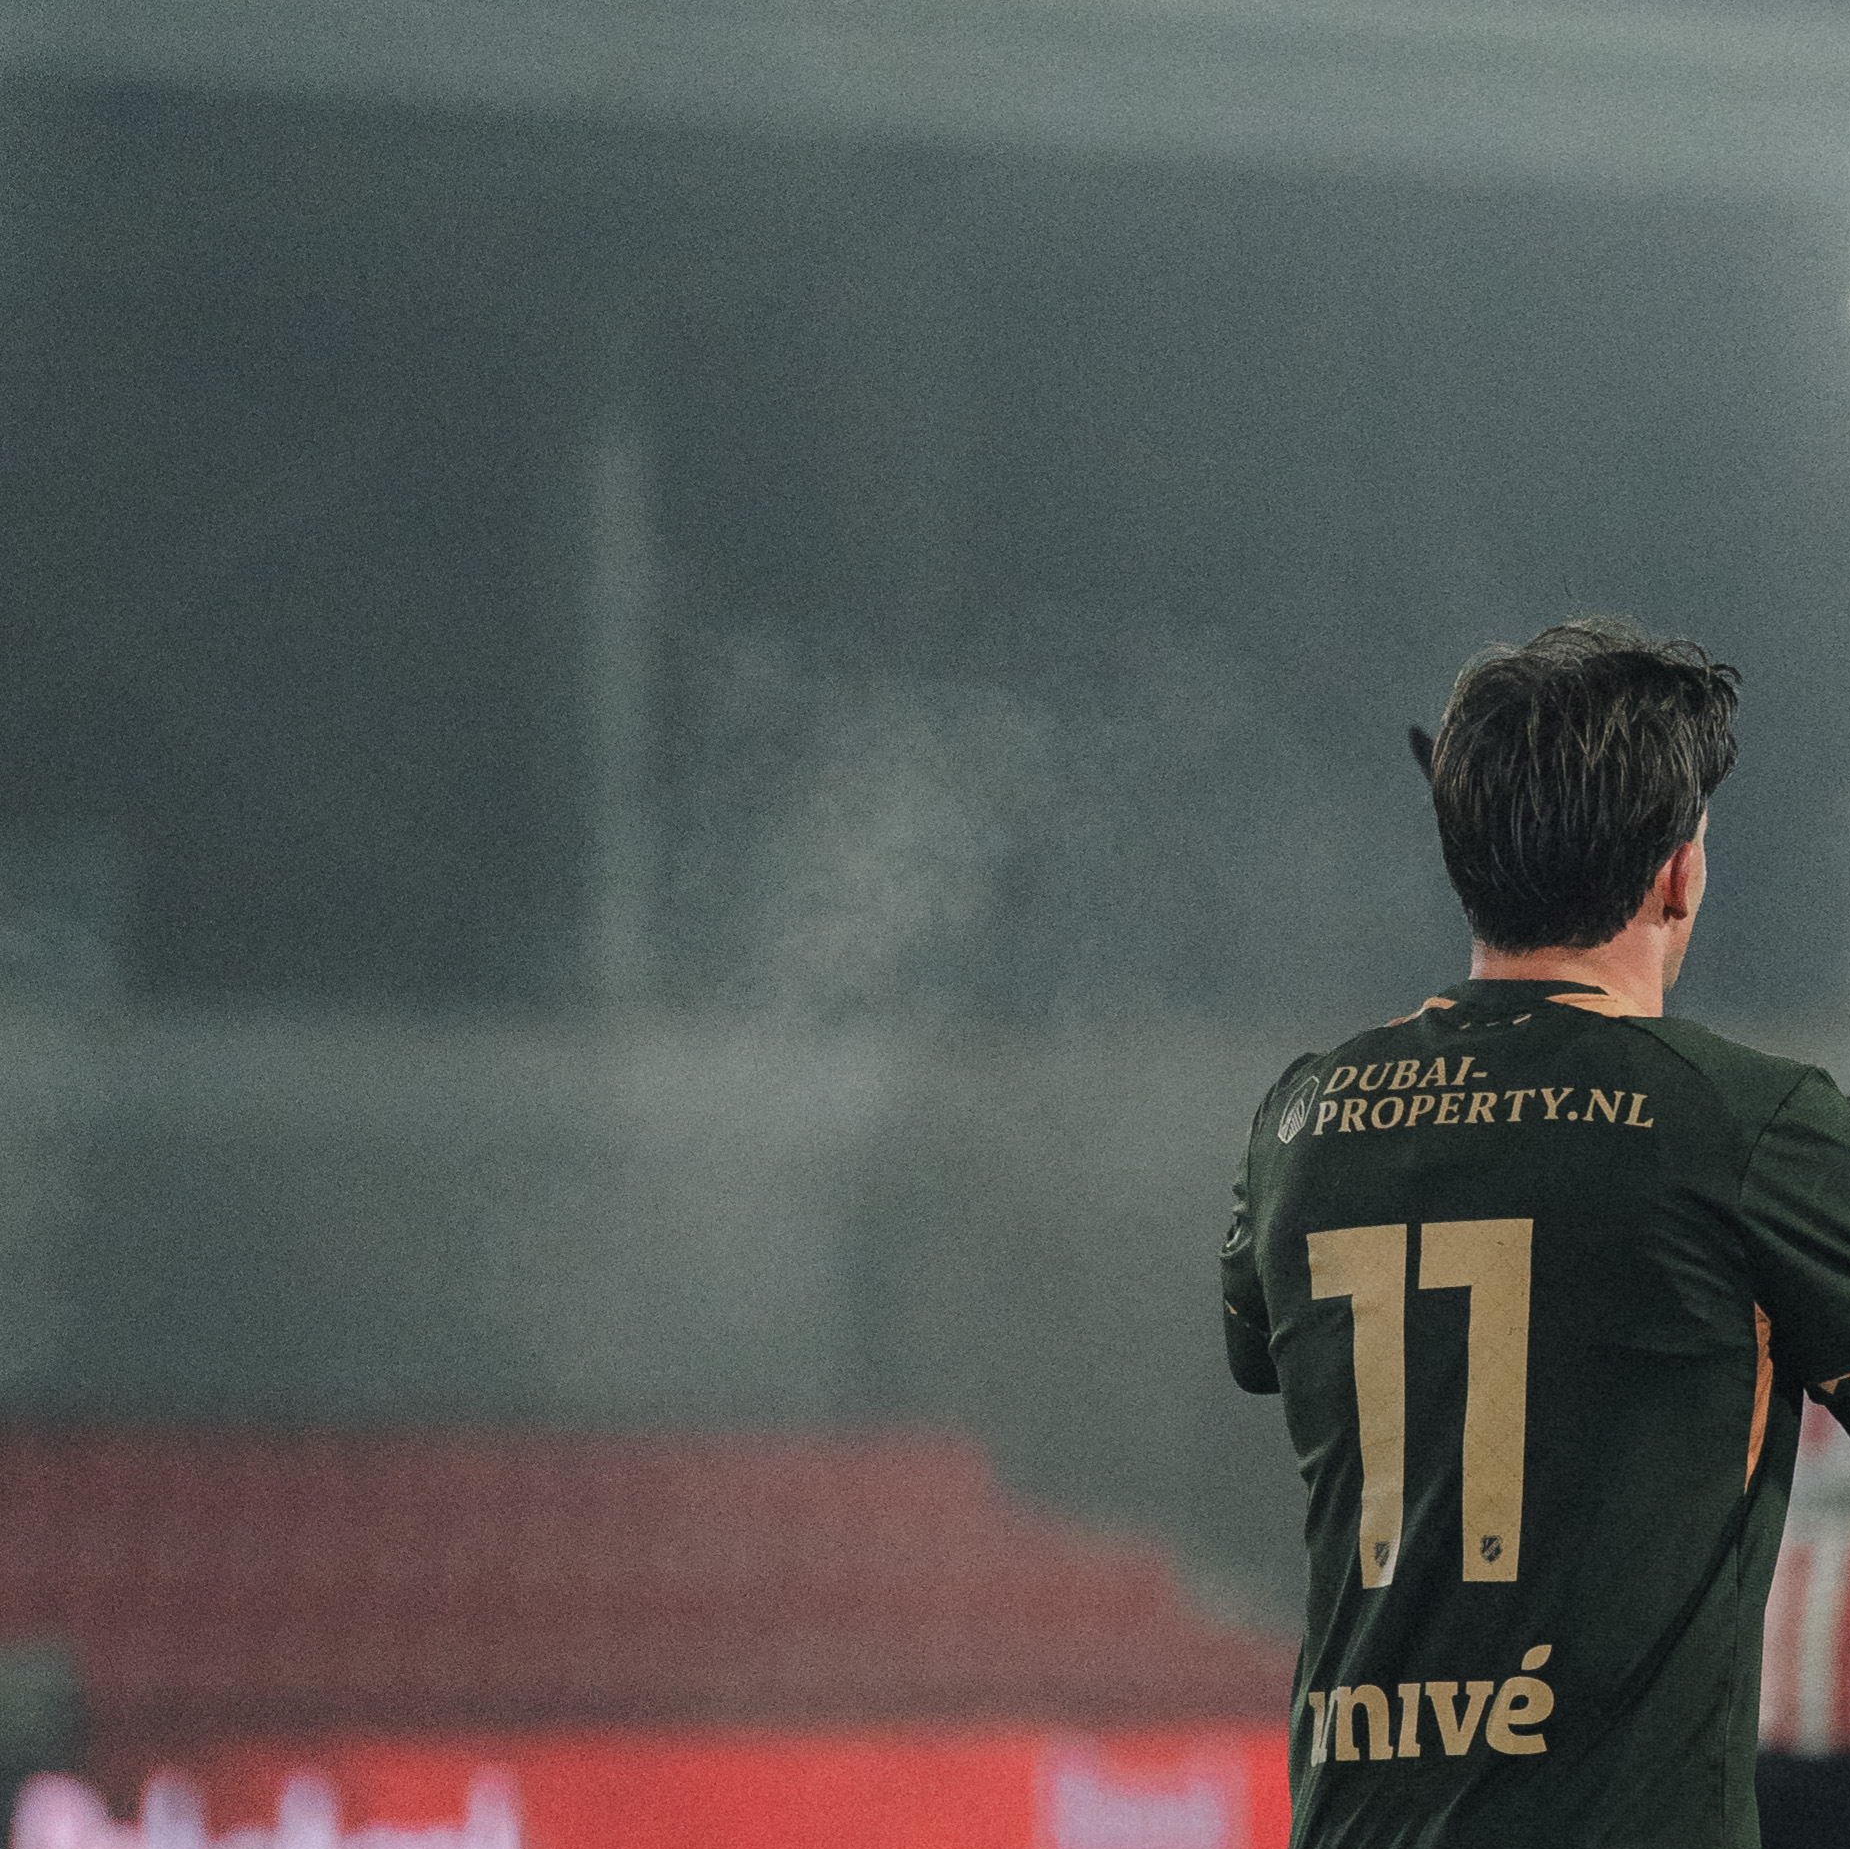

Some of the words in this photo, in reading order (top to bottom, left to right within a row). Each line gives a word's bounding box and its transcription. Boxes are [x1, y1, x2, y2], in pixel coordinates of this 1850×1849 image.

[1322, 1055, 1488, 1095] DUBAI-
[1312, 1086, 1655, 1136] PROPERTY.NL
[1307, 1218, 1534, 1590] 11
